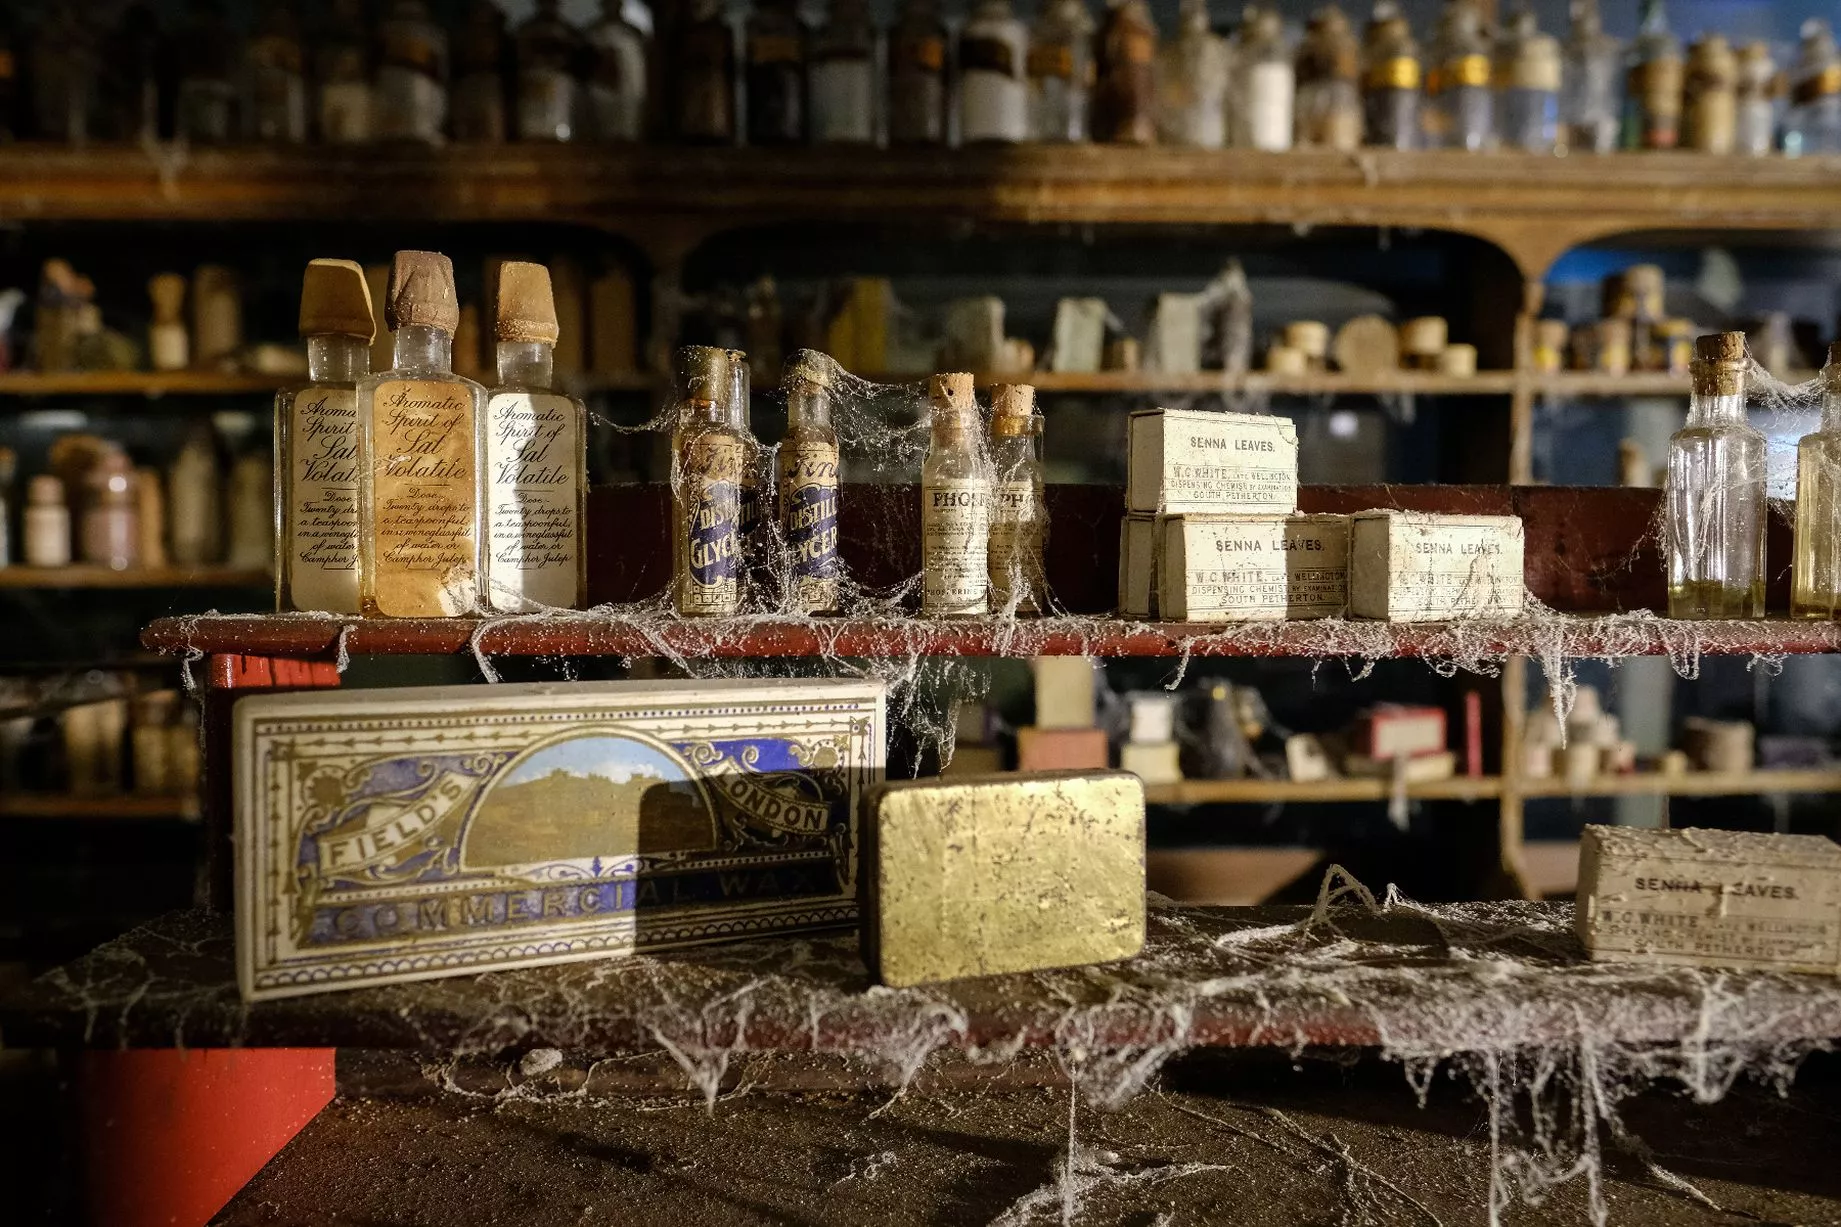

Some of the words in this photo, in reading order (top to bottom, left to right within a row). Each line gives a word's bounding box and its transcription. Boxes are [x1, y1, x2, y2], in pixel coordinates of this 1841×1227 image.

[301, 397, 357, 418] Aroma
[383, 388, 466, 411] Aromatic
[493, 401, 566, 421] Aromatic
[302, 415, 356, 442] Spirit
[385, 409, 440, 435] Spirit
[440, 413, 464, 434] of
[397, 428, 446, 454] Sal
[496, 420, 544, 446] Spirit
[544, 423, 566, 443] of
[313, 435, 357, 460] Sal
[506, 438, 549, 462] Sal
[1190, 436, 1227, 450] SENNA
[1235, 439, 1276, 452] LEAVES.
[300, 459, 358, 482] Volat
[384, 455, 467, 478] Volatile
[494, 461, 569, 484] Volatile
[1171, 480, 1213, 489] DISPENSING
[1193, 490, 1221, 499] SOUTH
[300, 502, 341, 519] Twenty
[383, 498, 425, 516] Twenty
[425, 500, 458, 516] drops
[458, 503, 470, 512] to
[495, 502, 532, 520] Twenty
[532, 505, 561, 519] drops
[561, 506, 573, 515] to
[789, 495, 838, 531] DISTILL
[310, 539, 327, 555] of
[392, 538, 411, 555] of
[409, 540, 443, 549] water
[505, 539, 520, 556] of
[518, 541, 548, 550] water
[548, 543, 564, 551] or
[690, 532, 736, 570] GLYC
[1215, 540, 1262, 551] SENNA
[1272, 539, 1325, 551] LEAVES.
[1415, 542, 1453, 555] SENNA
[299, 551, 349, 569] Camphor
[345, 553, 358, 569] J
[383, 550, 434, 569] Camphor
[496, 551, 540, 568] Camphor
[538, 551, 573, 569] Julep
[1191, 585, 1245, 595] DISPENSING
[1221, 595, 1256, 604] SOUTH
[717, 767, 823, 829] LONDON
[329, 778, 462, 865] FIELD'S
[1635, 877, 1701, 894] SENNA
[333, 878, 692, 935] COMMERCIAL
[717, 869, 816, 896] WAX
